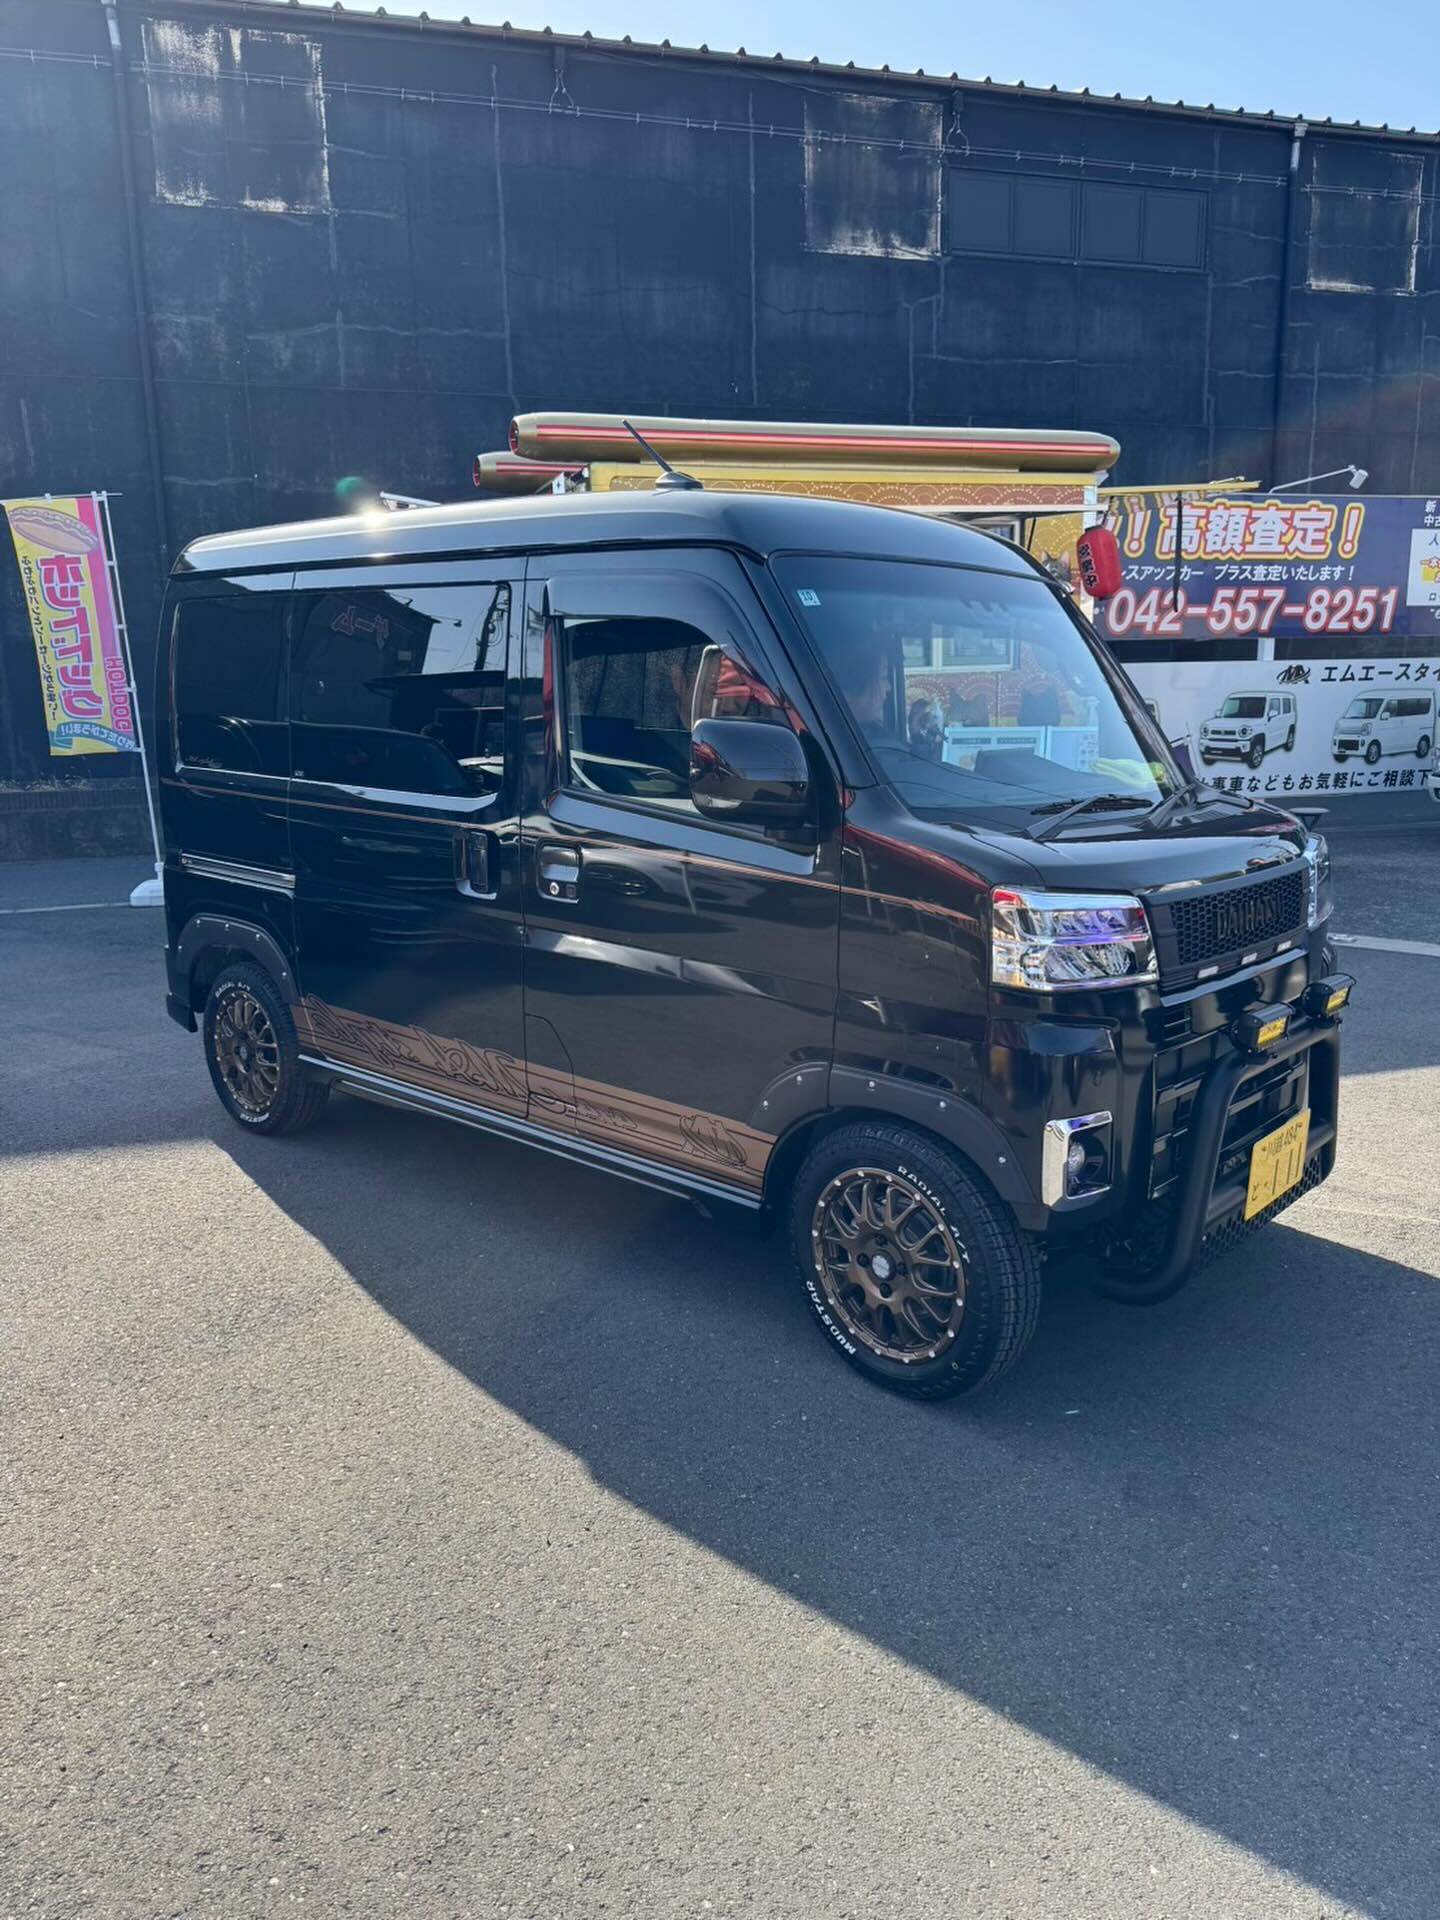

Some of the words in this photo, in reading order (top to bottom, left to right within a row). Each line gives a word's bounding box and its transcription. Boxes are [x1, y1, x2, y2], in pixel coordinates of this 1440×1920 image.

[1107, 588, 1398, 634] 042-557-8251
[897, 1165, 947, 1217] RADIAL
[949, 1224, 971, 1264] A/T
[806, 1280, 857, 1355] MUDSTAR
